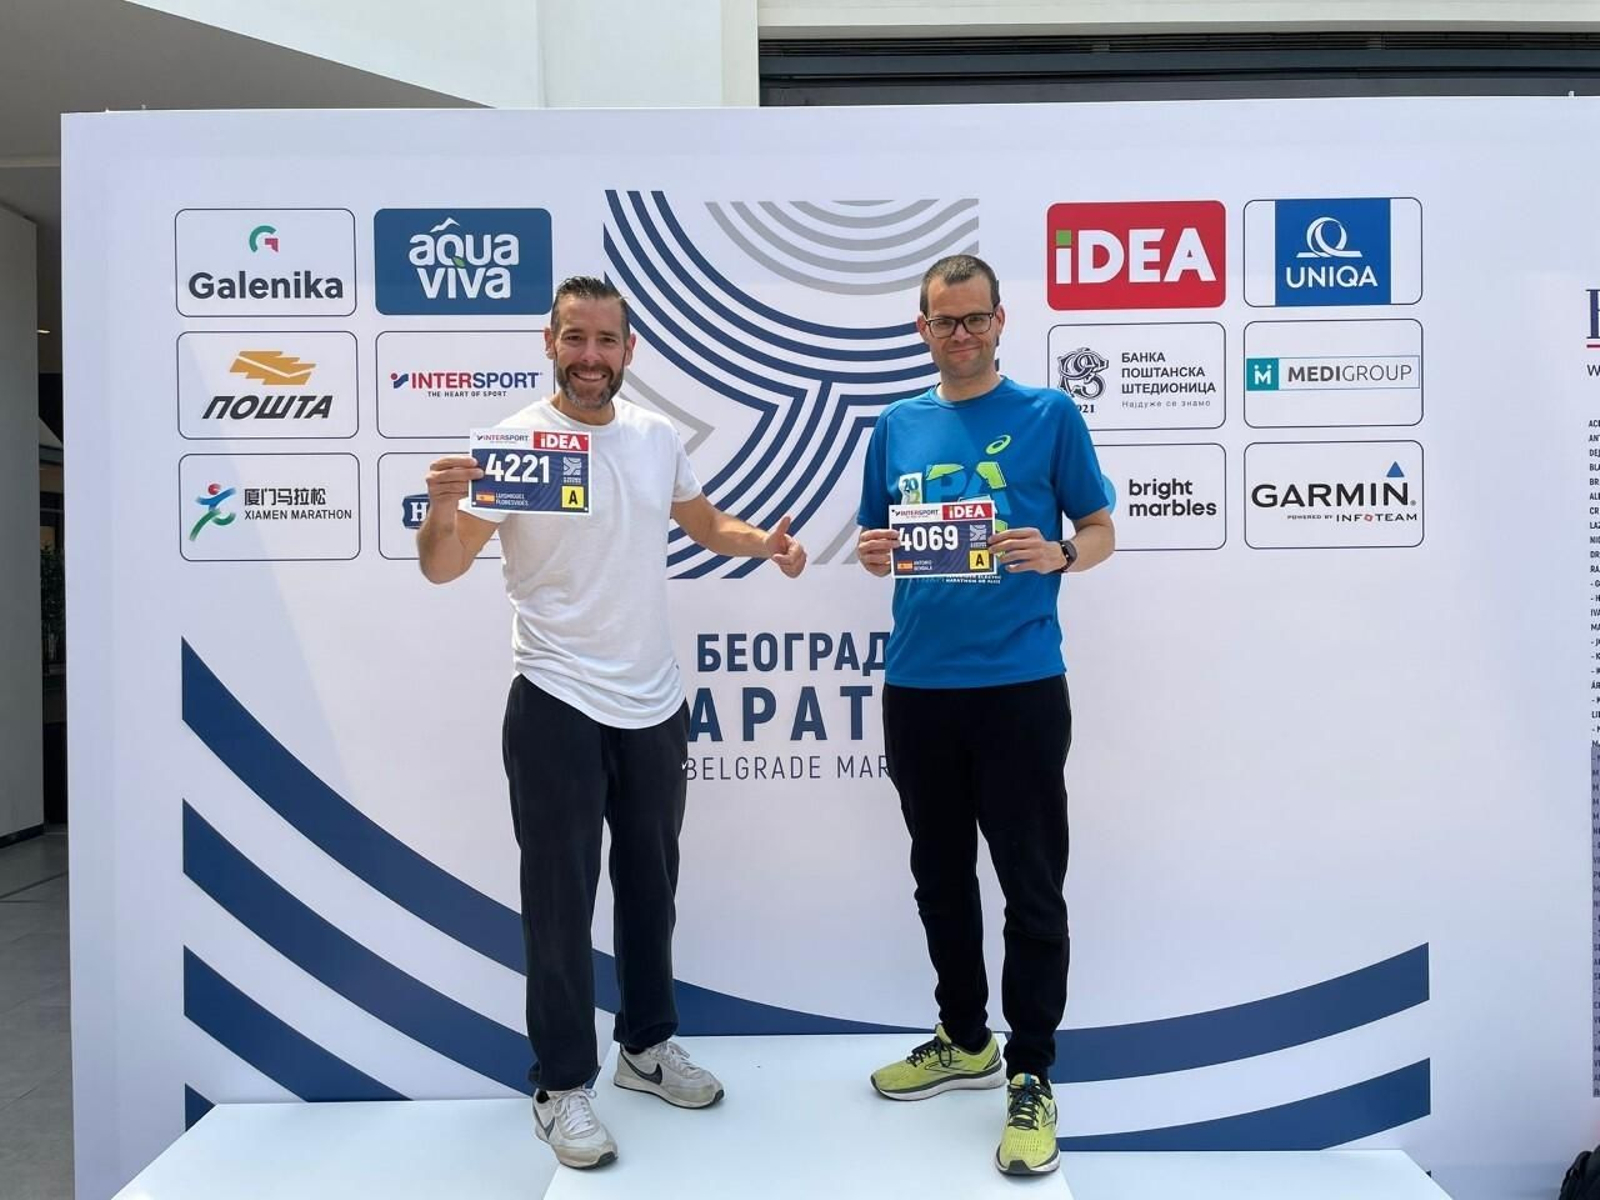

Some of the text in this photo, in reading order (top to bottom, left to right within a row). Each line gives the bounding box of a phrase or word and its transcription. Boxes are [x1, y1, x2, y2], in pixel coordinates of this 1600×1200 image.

[408, 233, 519, 266] aqua
[188, 271, 343, 299] Galenika
[416, 266, 511, 299] viva
[1286, 265, 1378, 288] UNIQA
[1121, 352, 1166, 363] БАНКА
[412, 372, 540, 389] INTERSPORT
[1121, 367, 1206, 379] ПОШТАНСКА
[1288, 364, 1412, 383] MEDIGROUP
[1121, 382, 1216, 395] ШТЕДИОНИЦА
[202, 395, 333, 419] ПОШТА
[483, 434, 530, 442] INTERSPORT
[485, 453, 550, 484] 4221
[902, 478, 919, 491] 20
[1129, 478, 1193, 502] bright
[244, 488, 327, 506] 厦门马拉松
[568, 490, 578, 505] A
[244, 509, 352, 520] XIAMEN MARATHON
[1129, 499, 1217, 516] marbles
[899, 525, 959, 551] 4069
[975, 553, 985, 567] A
[697, 632, 891, 677] БЕОГРАД
[687, 685, 873, 742] АРАТ
[686, 755, 890, 781] BELGRADE MAR
